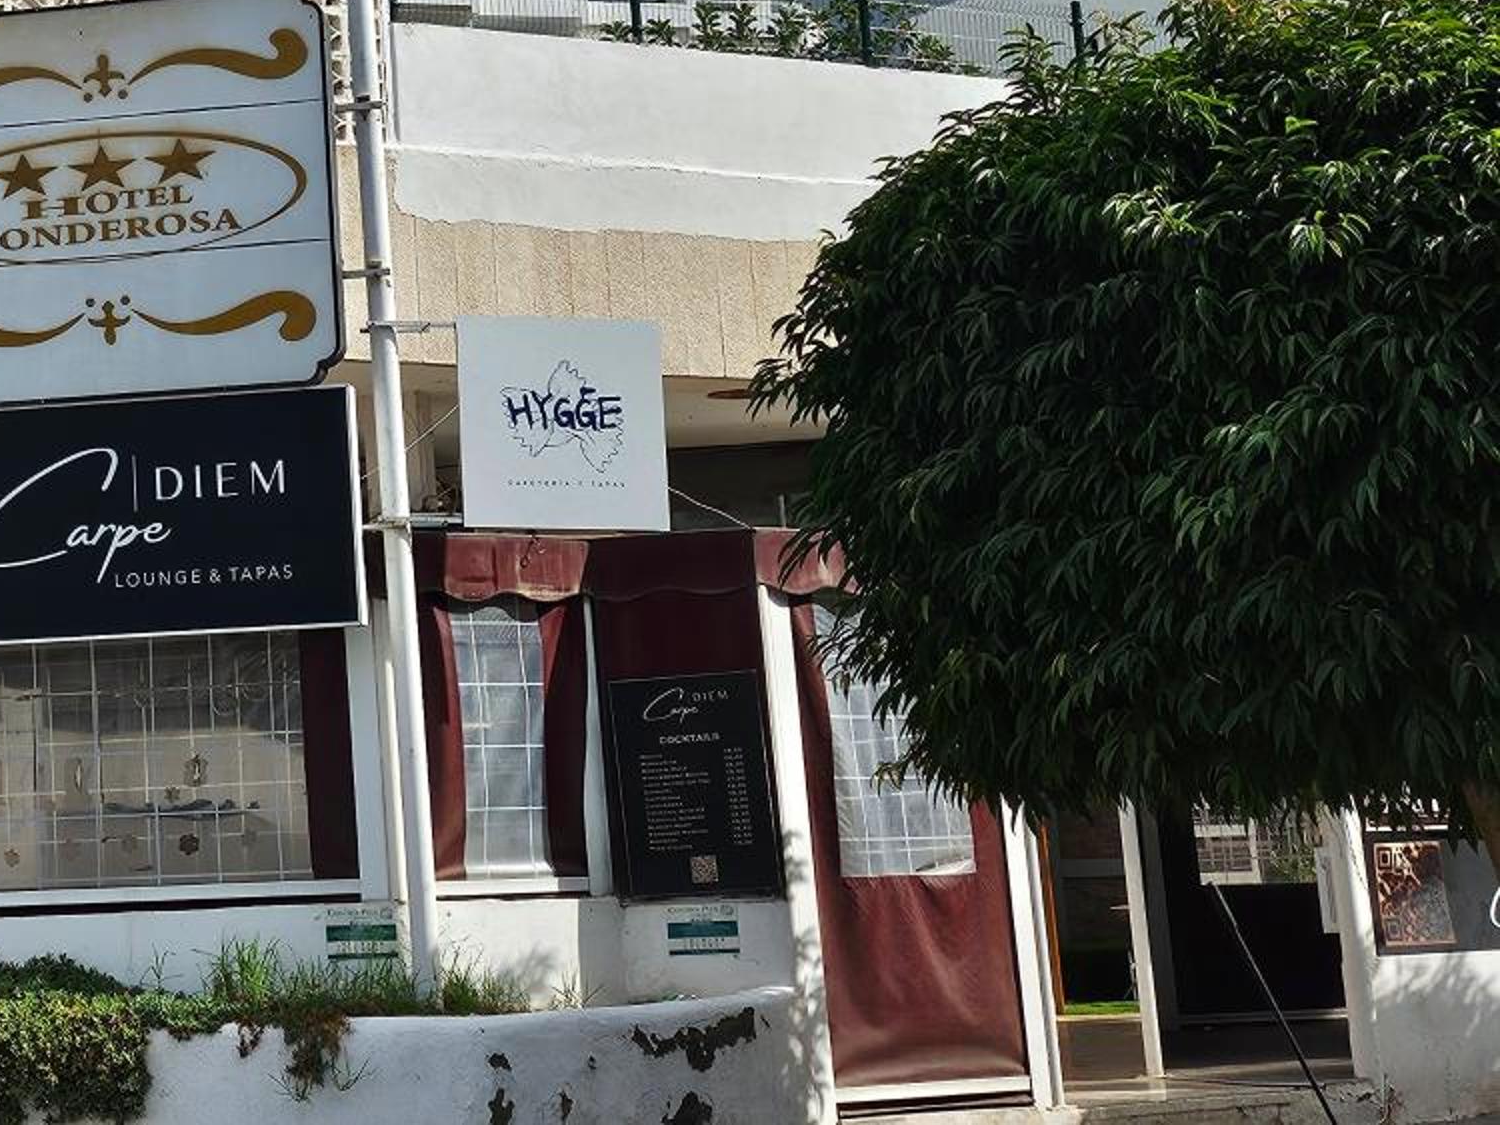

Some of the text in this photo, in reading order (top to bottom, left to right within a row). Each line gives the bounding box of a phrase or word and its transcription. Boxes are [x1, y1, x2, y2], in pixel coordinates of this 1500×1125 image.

[21, 184, 193, 221] HOTEL
[154, 459, 287, 500] DIEM
[114, 563, 294, 588] LOUNGE & TAPAS
